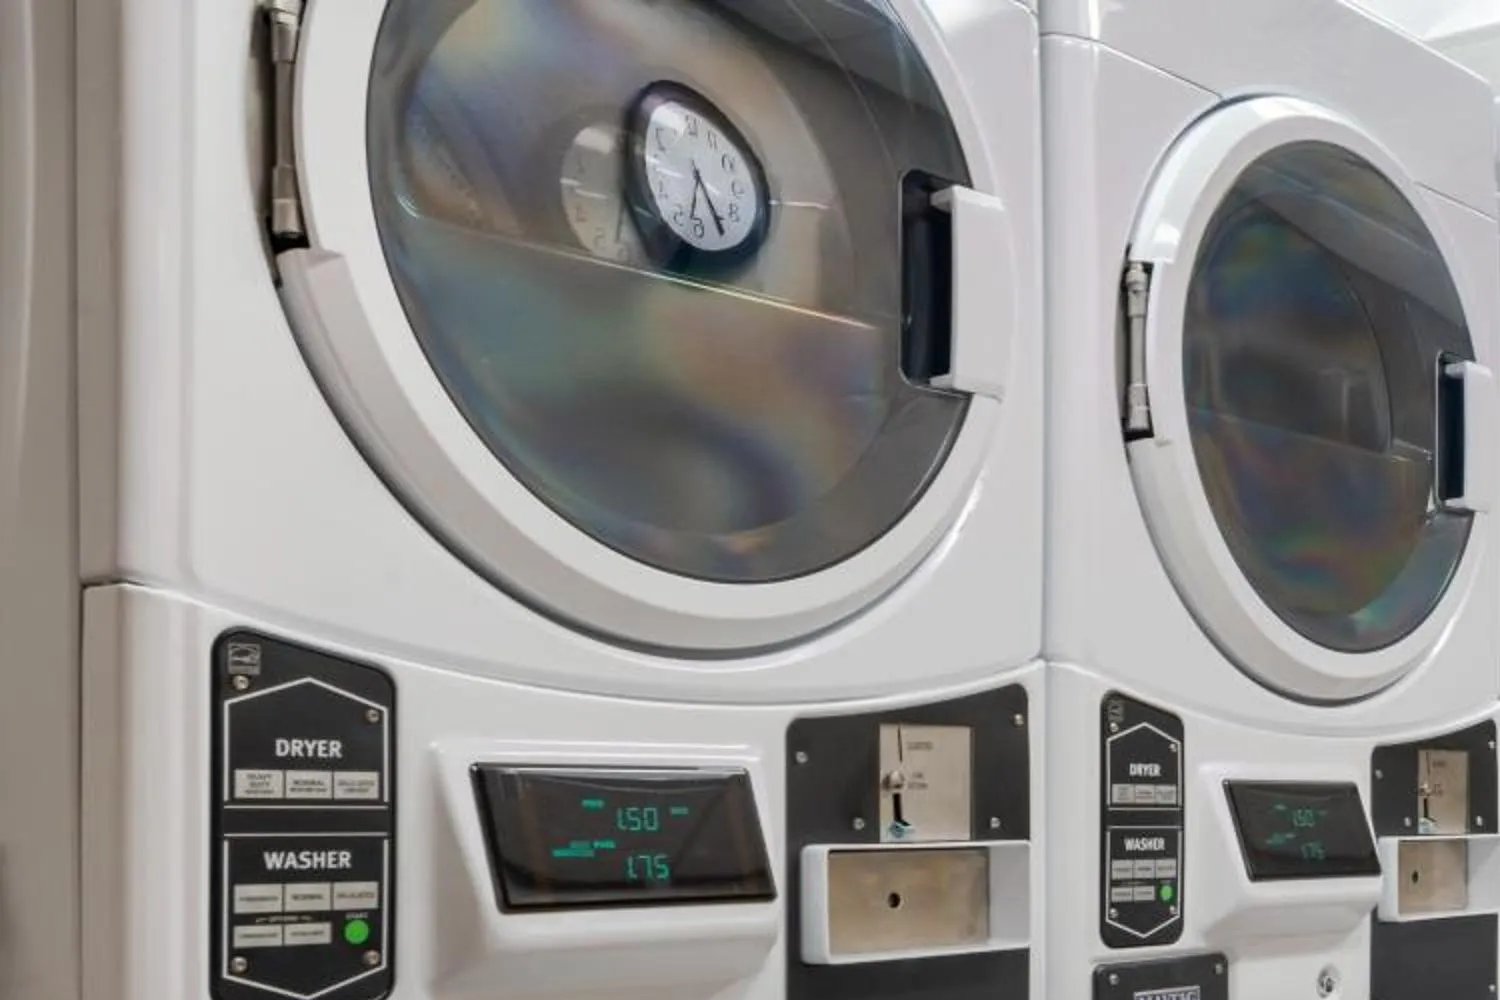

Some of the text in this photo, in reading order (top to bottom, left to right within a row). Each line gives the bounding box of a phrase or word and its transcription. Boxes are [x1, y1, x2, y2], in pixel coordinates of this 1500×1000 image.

[275, 737, 343, 758] DRYER
[1124, 837, 1166, 851] WASHER
[264, 850, 352, 871] WASHER
